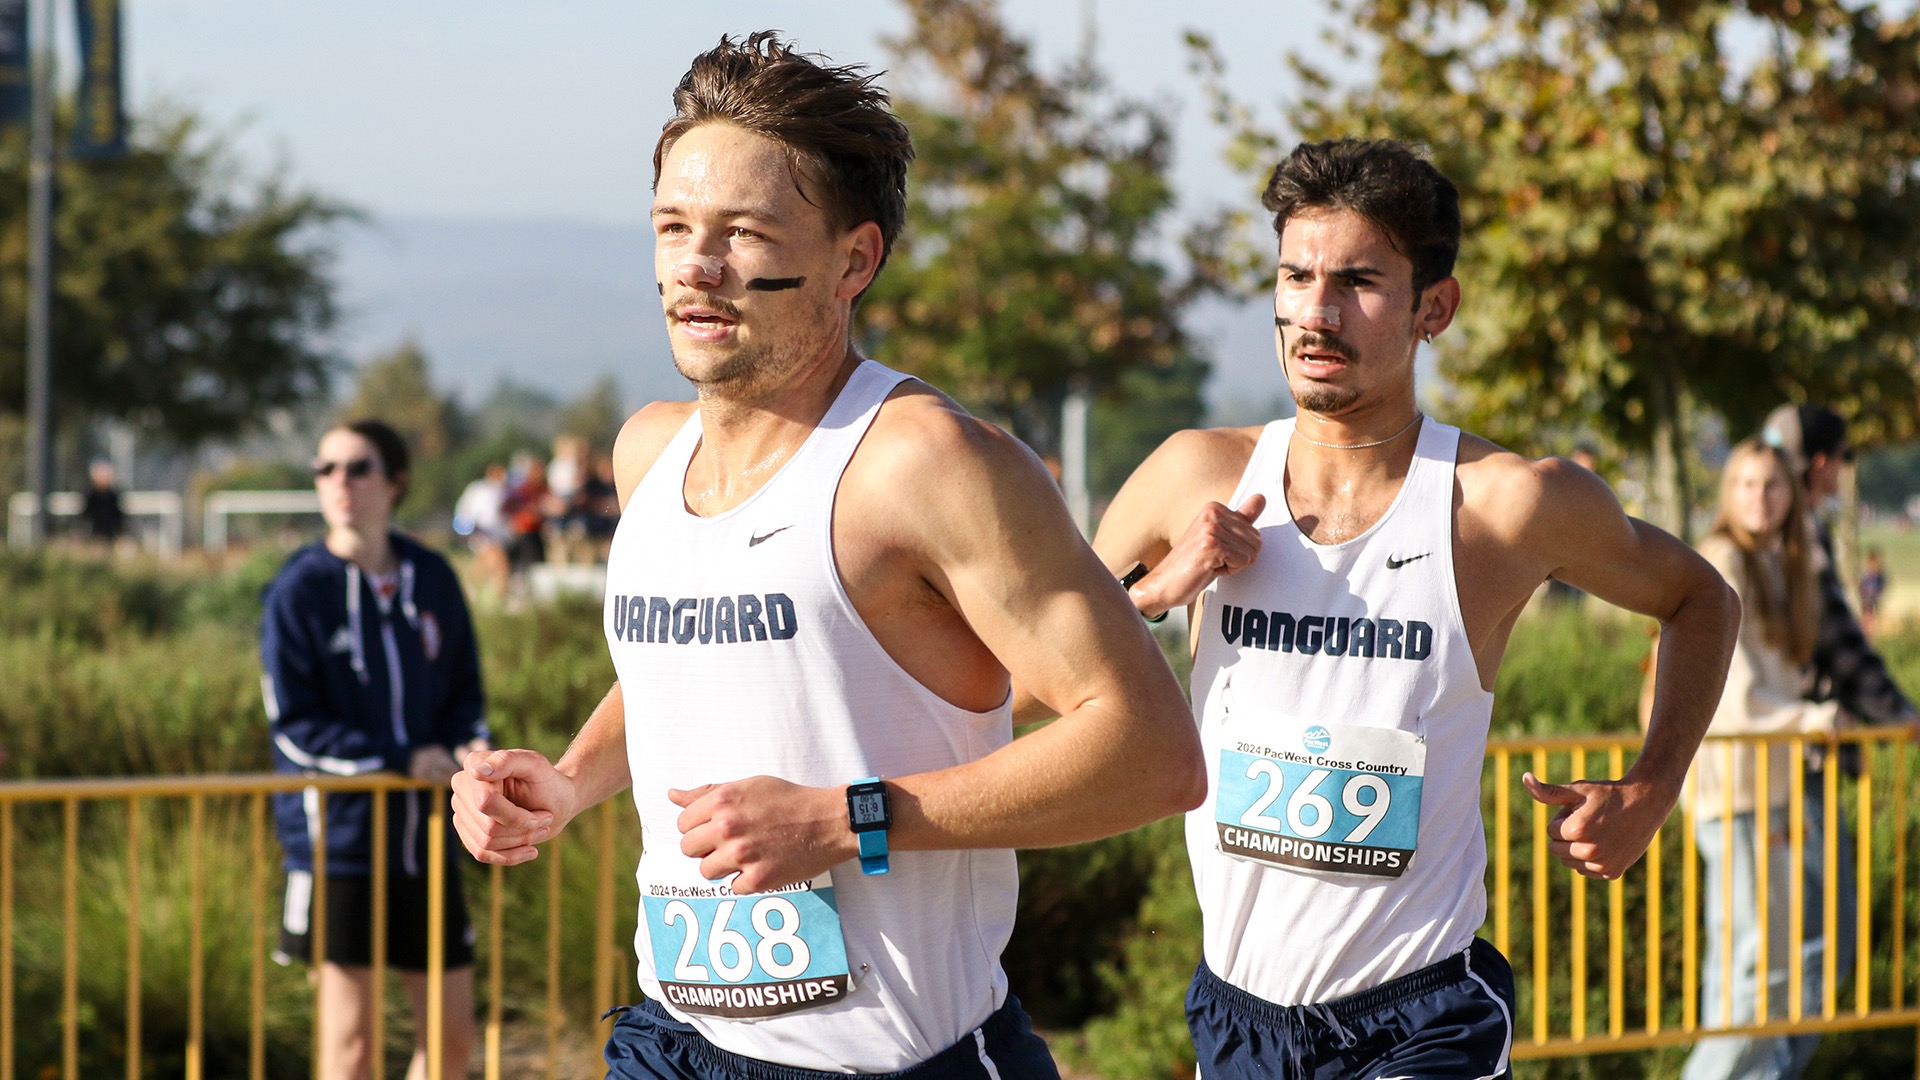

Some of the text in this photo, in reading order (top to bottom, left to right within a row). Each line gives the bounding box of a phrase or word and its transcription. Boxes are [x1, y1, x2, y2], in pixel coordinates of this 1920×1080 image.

[614, 593, 798, 644] VANGUARD
[1221, 604, 1433, 661] VANGUARD
[1236, 742, 1408, 776] 2024 PacWest Cross Country
[859, 802, 878, 814] 6:15
[1239, 758, 1391, 843] 269
[1224, 827, 1401, 868] CHAMPIONSHIPS
[650, 884, 669, 896] 2024
[672, 886, 716, 897] PacWest
[663, 896, 811, 983] 268
[667, 980, 839, 1008] CHAMPIONSHIPS
